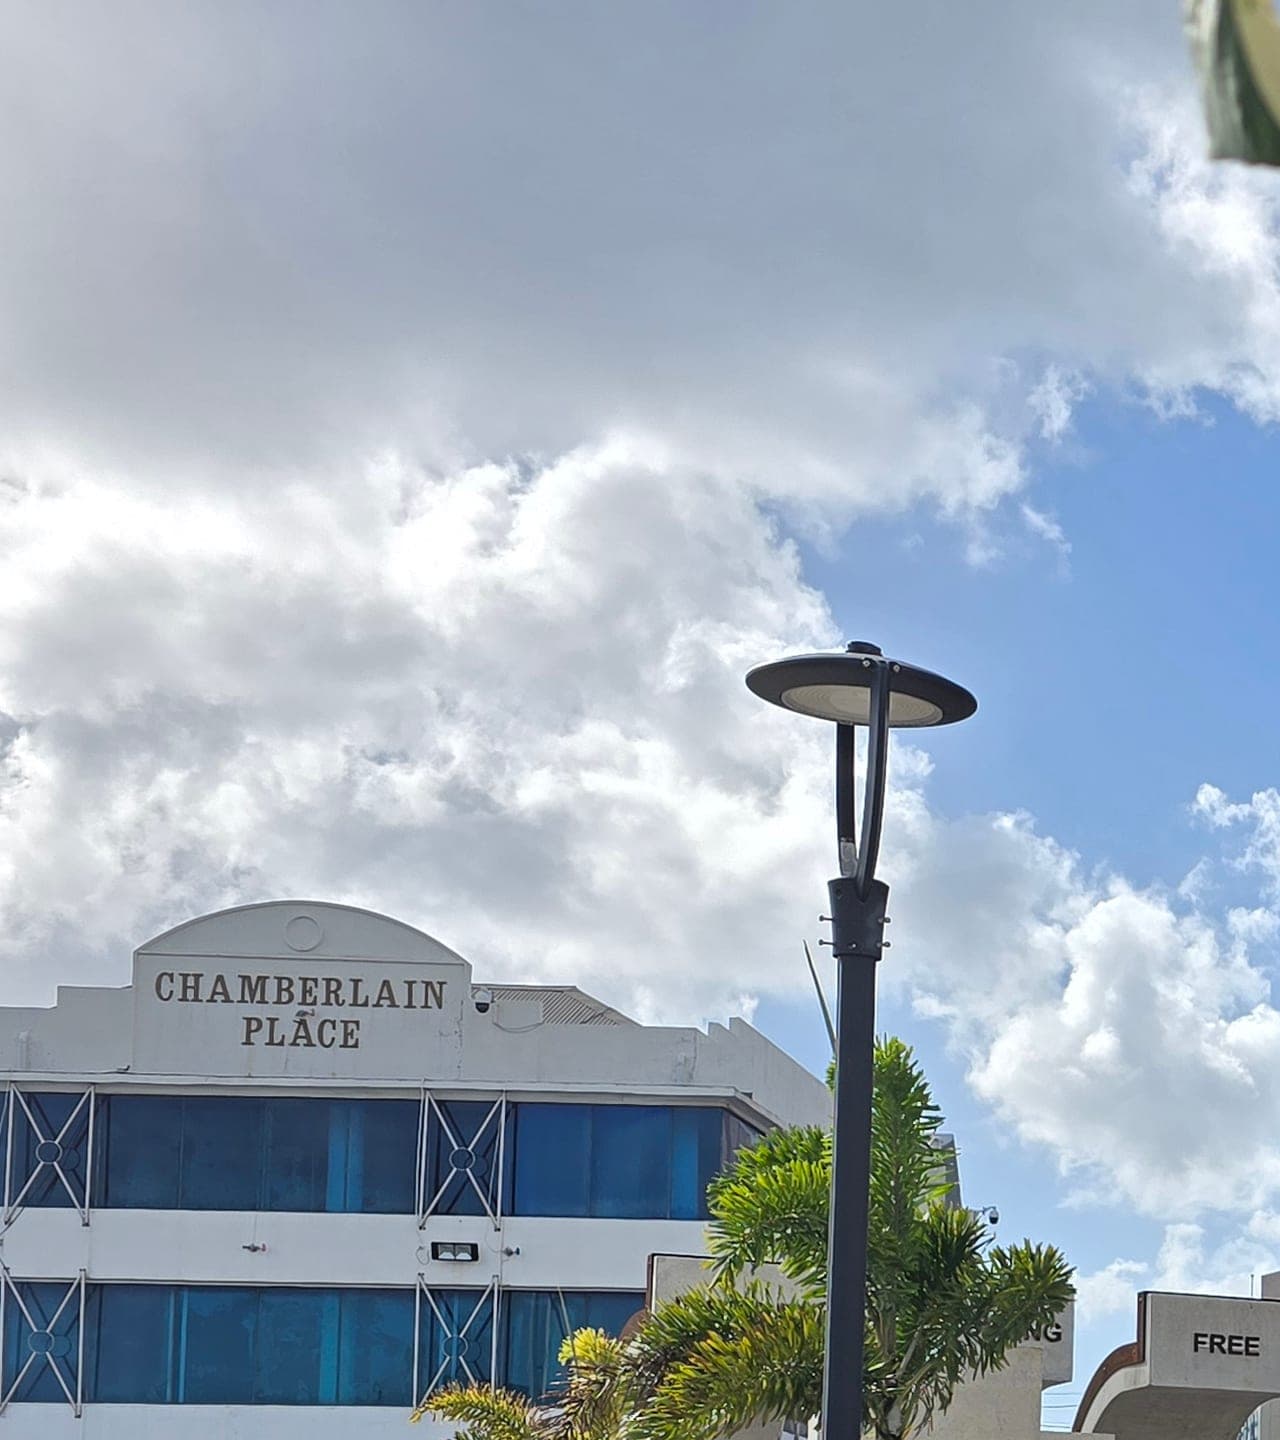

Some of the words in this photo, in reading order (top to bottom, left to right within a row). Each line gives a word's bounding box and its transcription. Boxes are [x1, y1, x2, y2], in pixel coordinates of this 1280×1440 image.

[154, 971, 447, 1010] CHAMBERLAIN
[241, 1016, 361, 1049] PLACE
[1193, 1332, 1261, 1357] FREE
